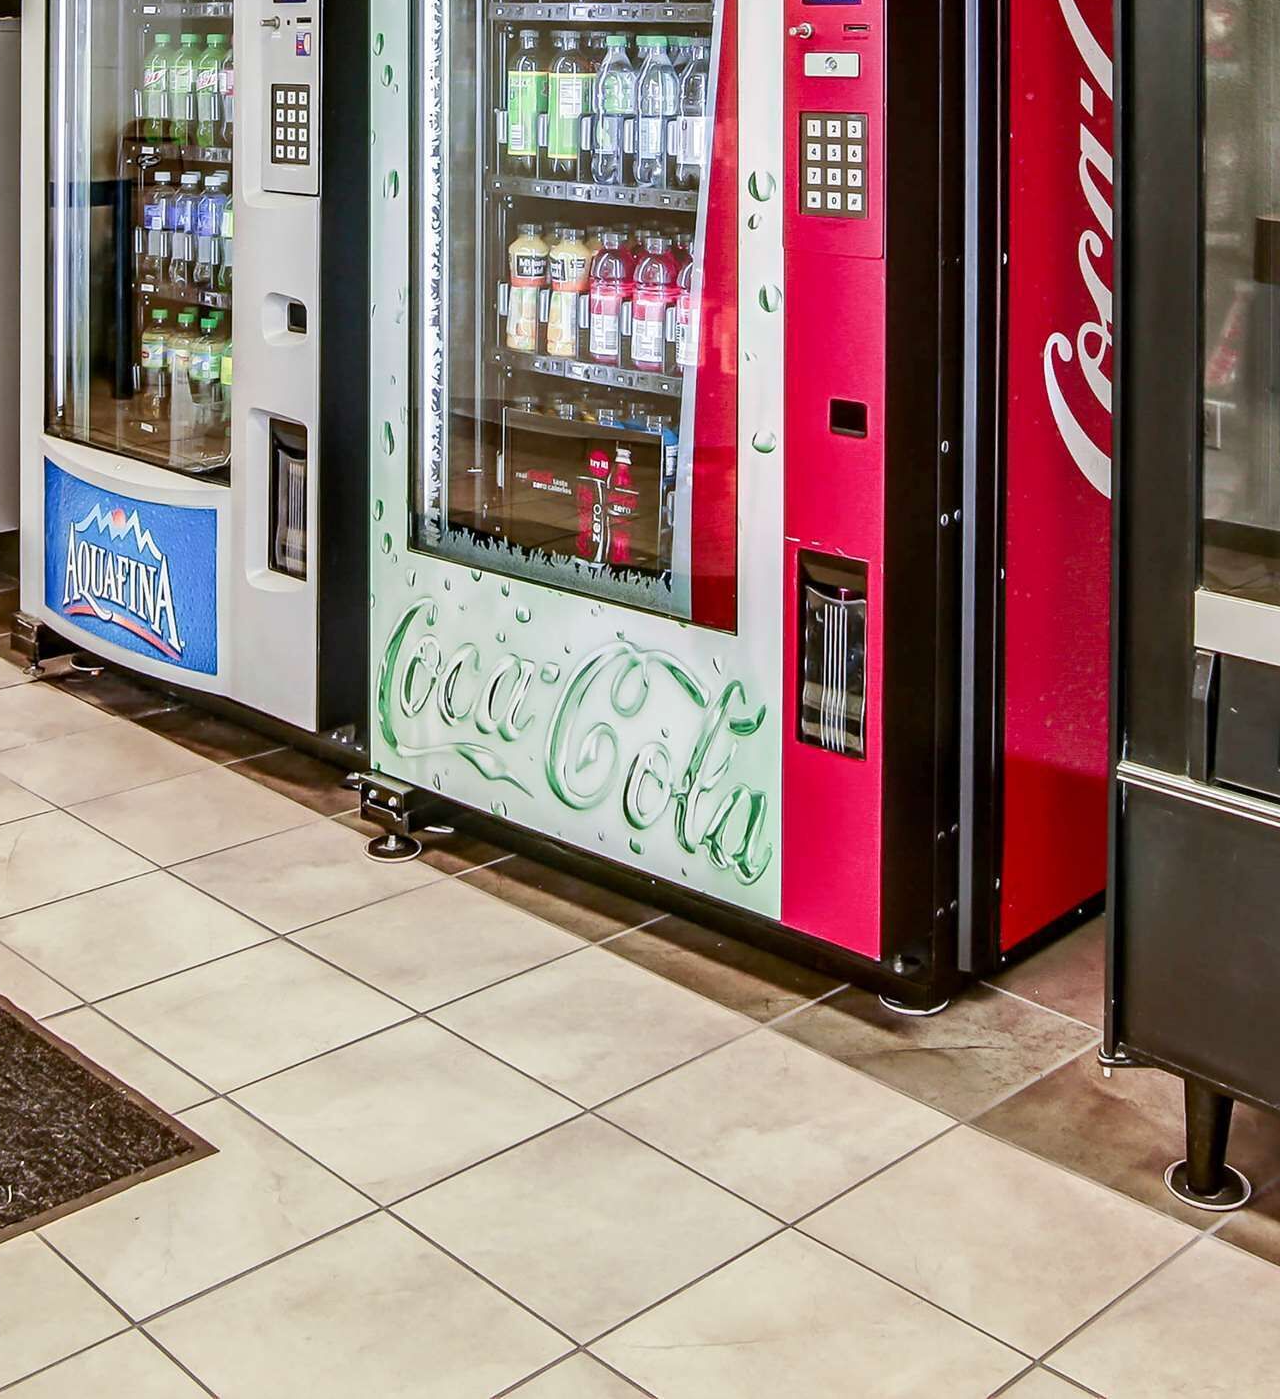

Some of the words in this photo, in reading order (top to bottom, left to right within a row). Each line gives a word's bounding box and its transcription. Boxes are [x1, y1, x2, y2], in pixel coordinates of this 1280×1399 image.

[592, 504, 602, 542] zero
[613, 504, 631, 514] zero
[63, 521, 185, 653] AQUAFINA
